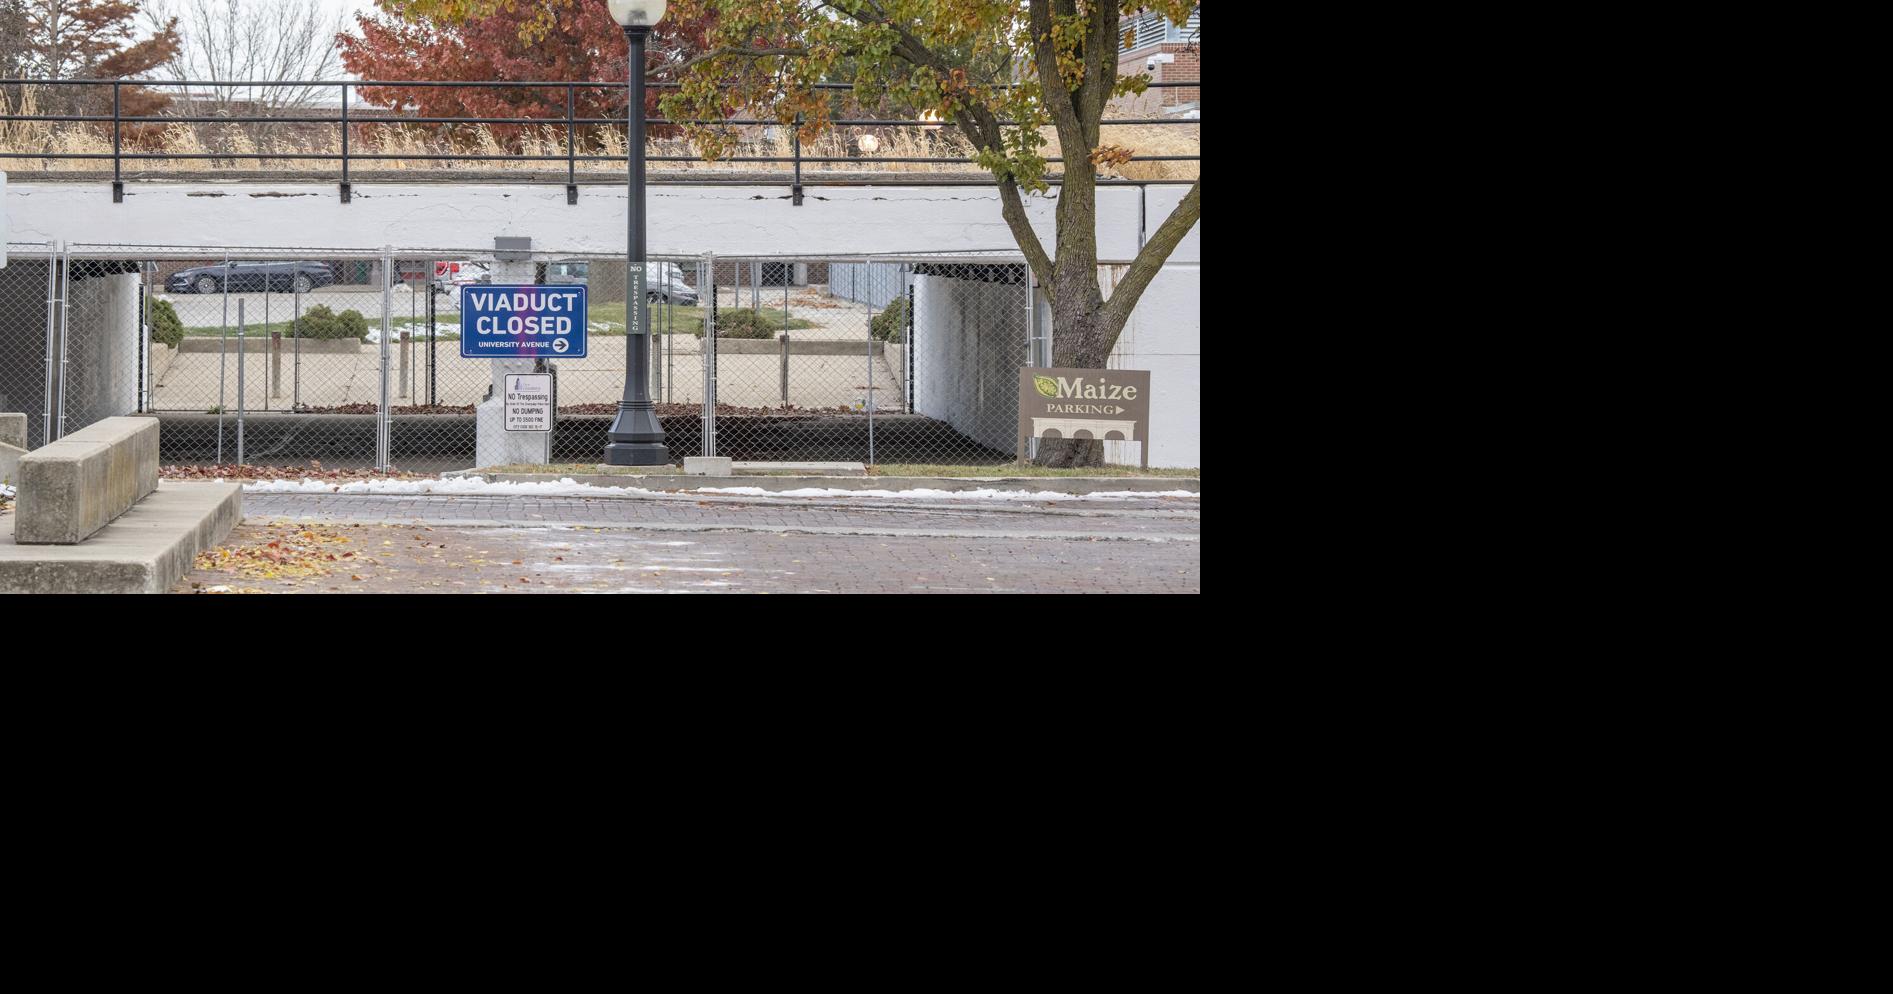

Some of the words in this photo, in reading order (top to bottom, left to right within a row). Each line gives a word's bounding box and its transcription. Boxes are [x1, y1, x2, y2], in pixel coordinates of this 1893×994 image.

[471, 293, 577, 312] VIADUCT
[476, 316, 572, 335] CLOSED
[517, 393, 549, 401] Trespassing
[1056, 377, 1137, 400] Maize
[1047, 404, 1113, 415] PARKING
